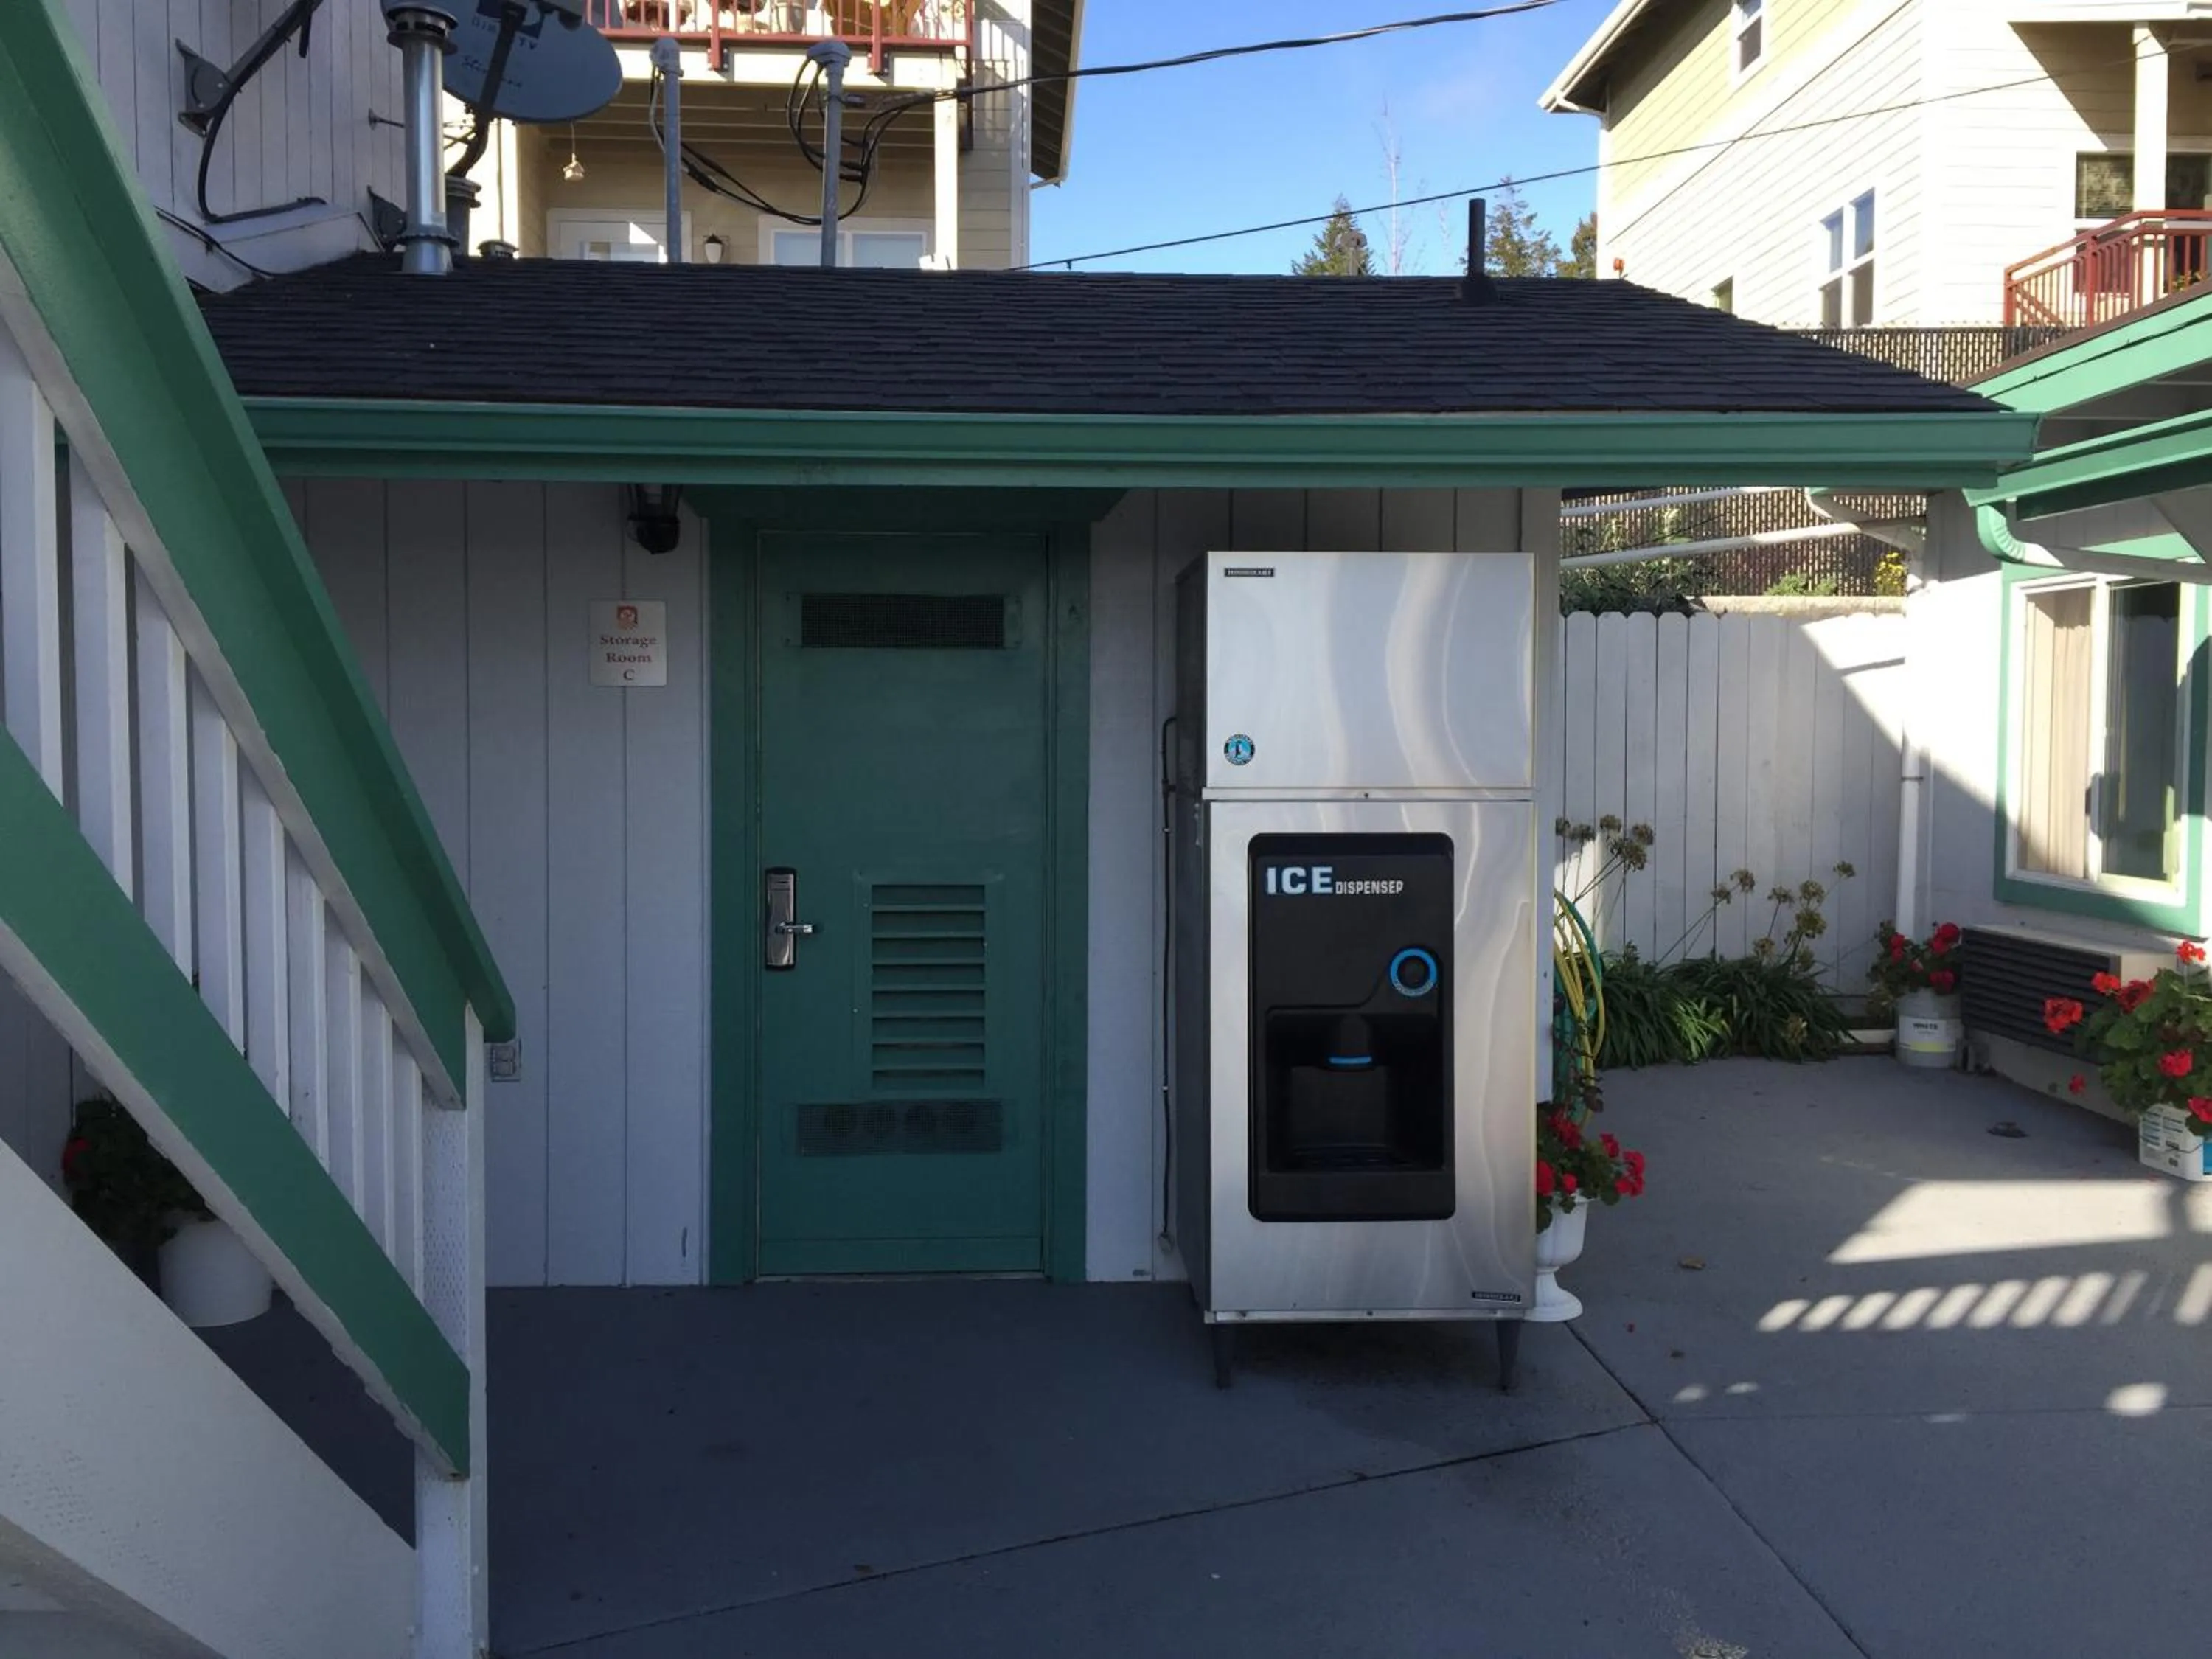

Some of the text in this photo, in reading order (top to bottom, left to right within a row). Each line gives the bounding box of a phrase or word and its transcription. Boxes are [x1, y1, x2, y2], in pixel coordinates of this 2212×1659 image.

[600, 635, 658, 647] Storage
[605, 652, 653, 663] Room
[623, 669, 635, 680] C
[1267, 866, 1404, 894] ICE DISPENSER
